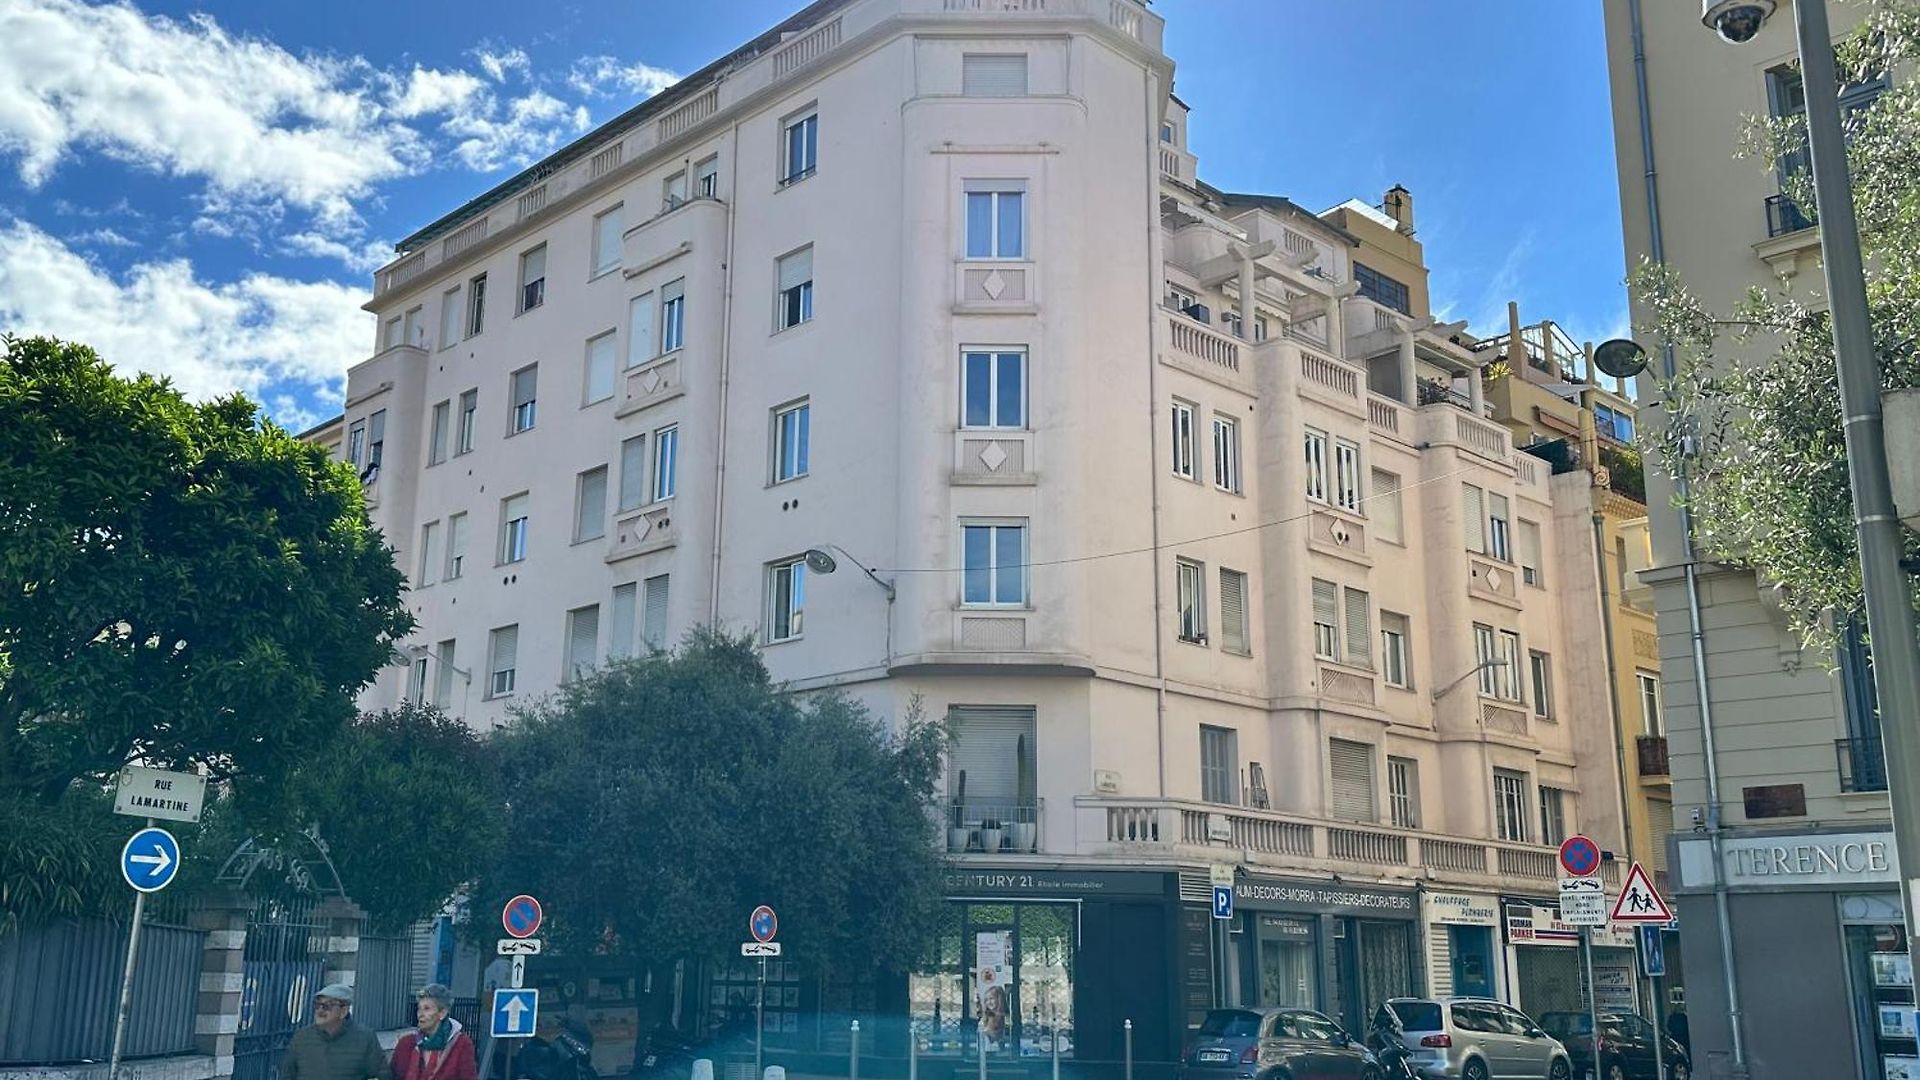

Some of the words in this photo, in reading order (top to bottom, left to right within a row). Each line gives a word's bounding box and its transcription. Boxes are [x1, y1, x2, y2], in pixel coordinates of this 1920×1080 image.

[154, 779, 173, 791] RUE
[131, 795, 189, 812] LAMARTINE
[1727, 841, 1889, 877] TERENCE
[1020, 875, 1033, 888] 21
[1217, 892, 1228, 912] P
